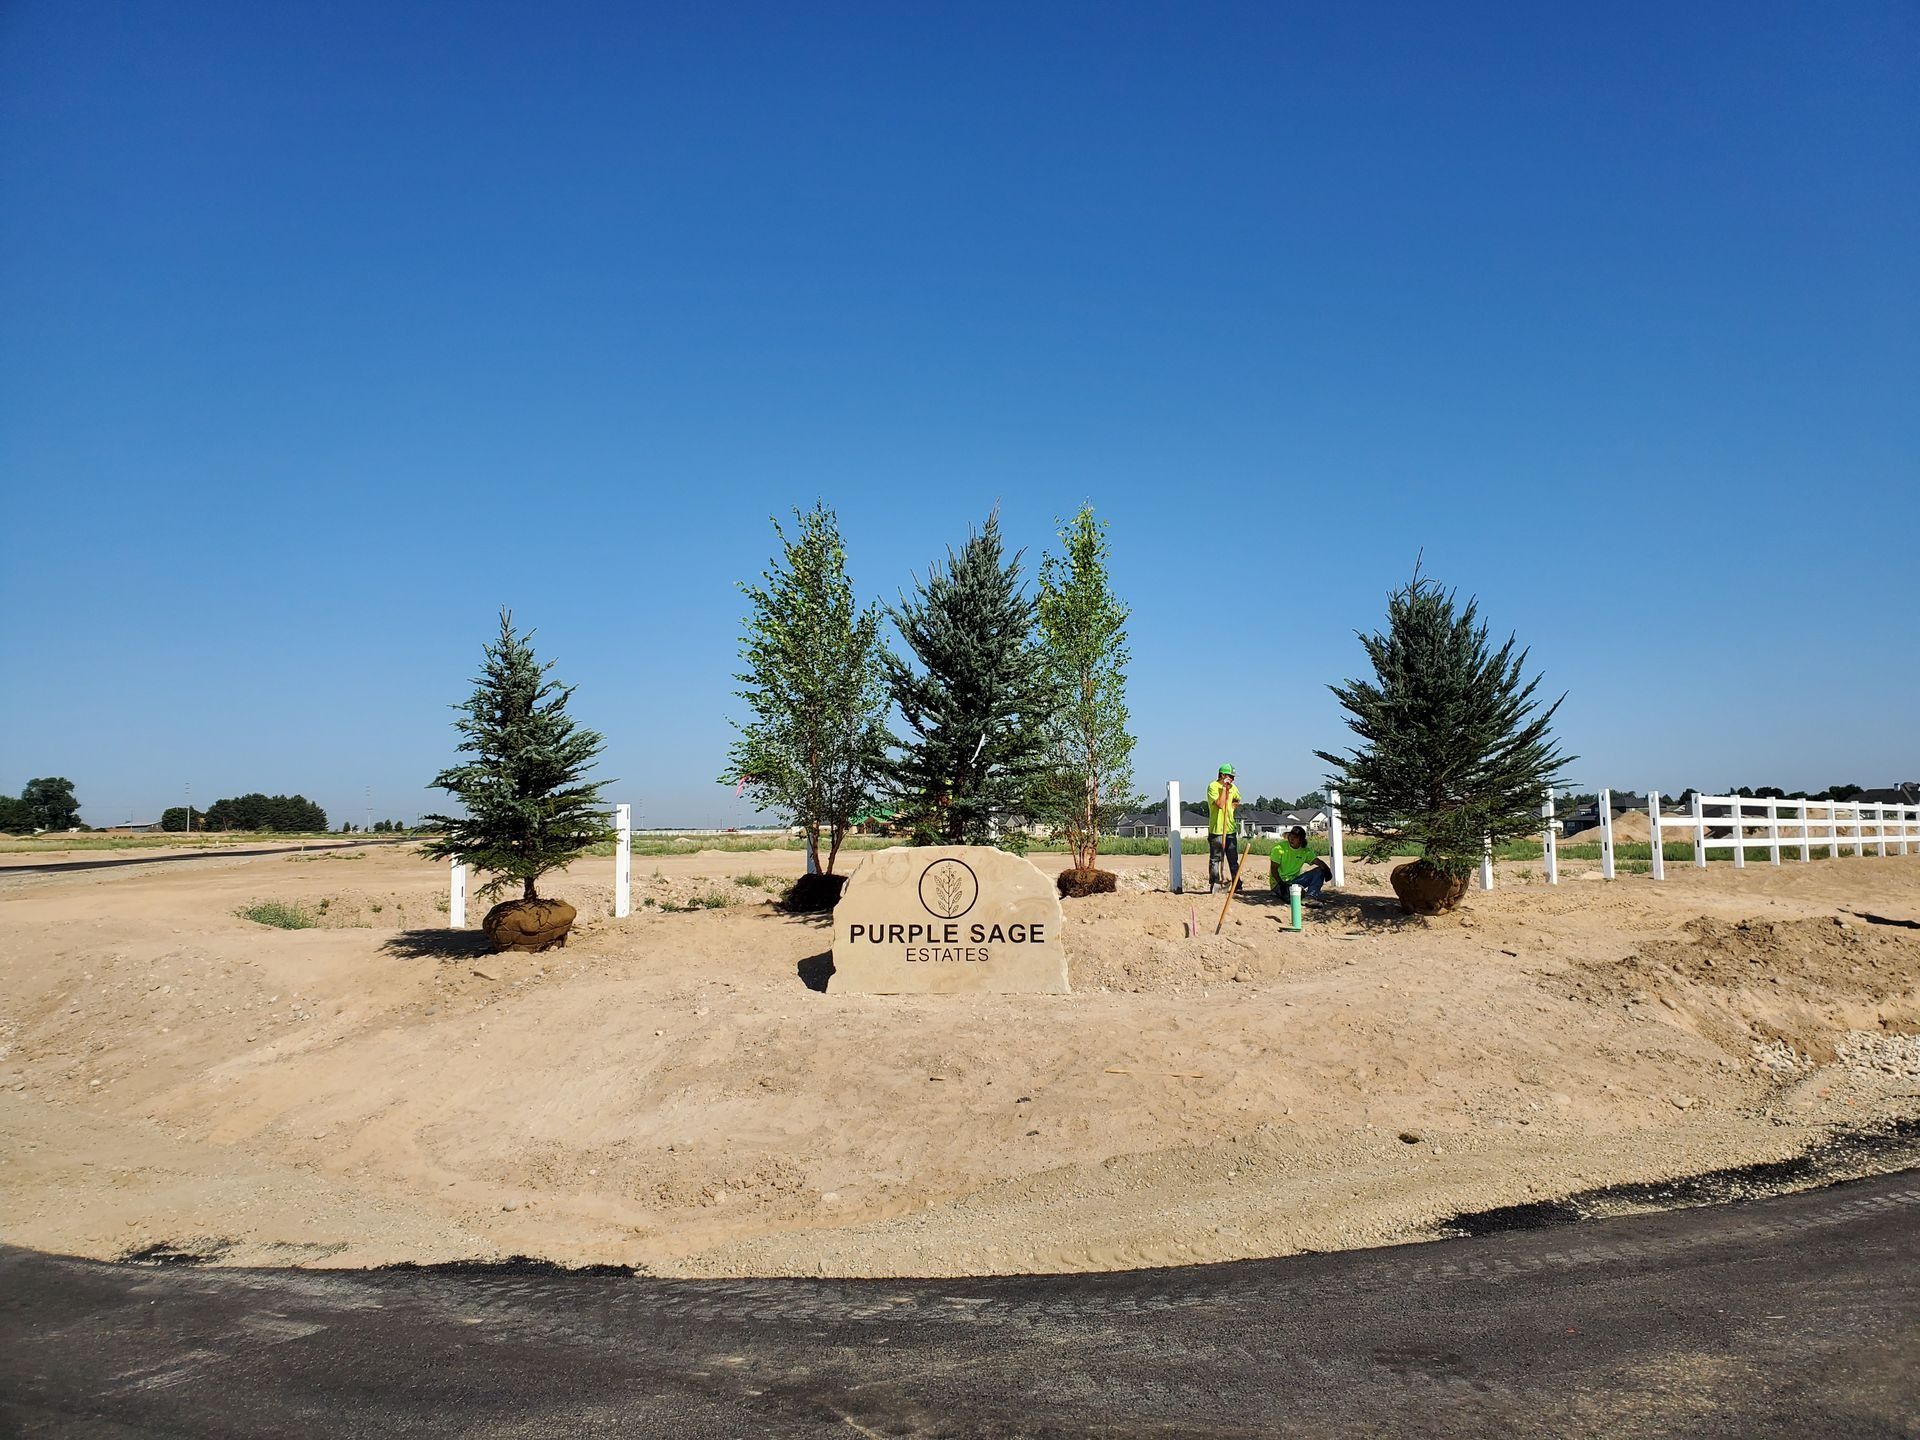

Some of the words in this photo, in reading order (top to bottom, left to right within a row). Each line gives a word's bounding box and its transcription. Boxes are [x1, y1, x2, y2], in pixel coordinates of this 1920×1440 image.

[850, 923, 959, 944] PURPLE
[970, 923, 1045, 944] SAGE
[906, 947, 989, 962] ESTATES
